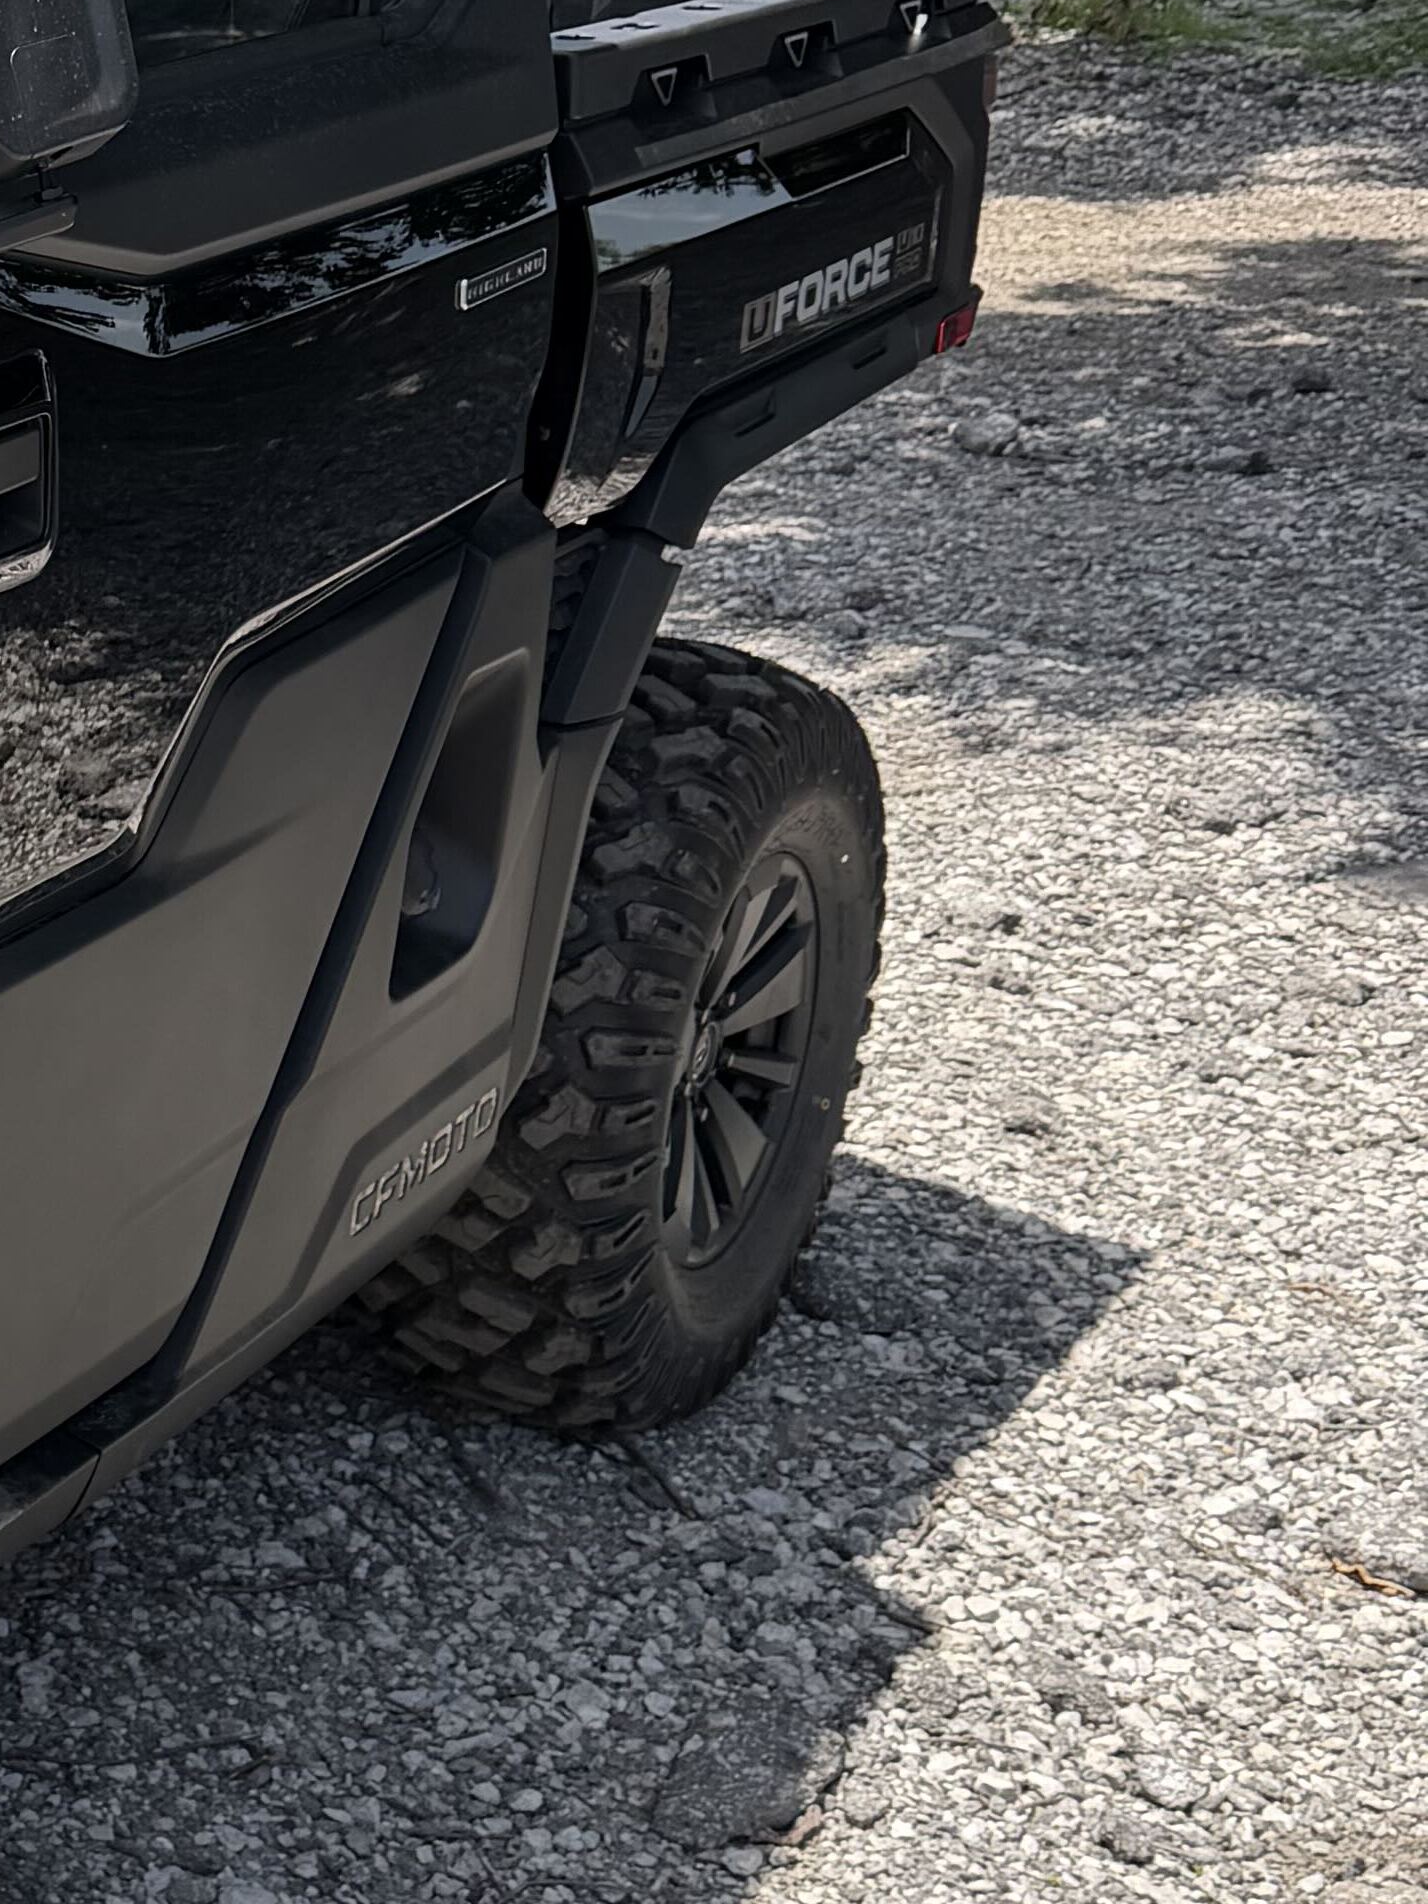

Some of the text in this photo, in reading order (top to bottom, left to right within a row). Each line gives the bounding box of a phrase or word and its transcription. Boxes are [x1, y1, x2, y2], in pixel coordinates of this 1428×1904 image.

[467, 255, 543, 300] HIGHLAND
[740, 236, 895, 354] UFORCE
[349, 1087, 500, 1236] CFMOTO
